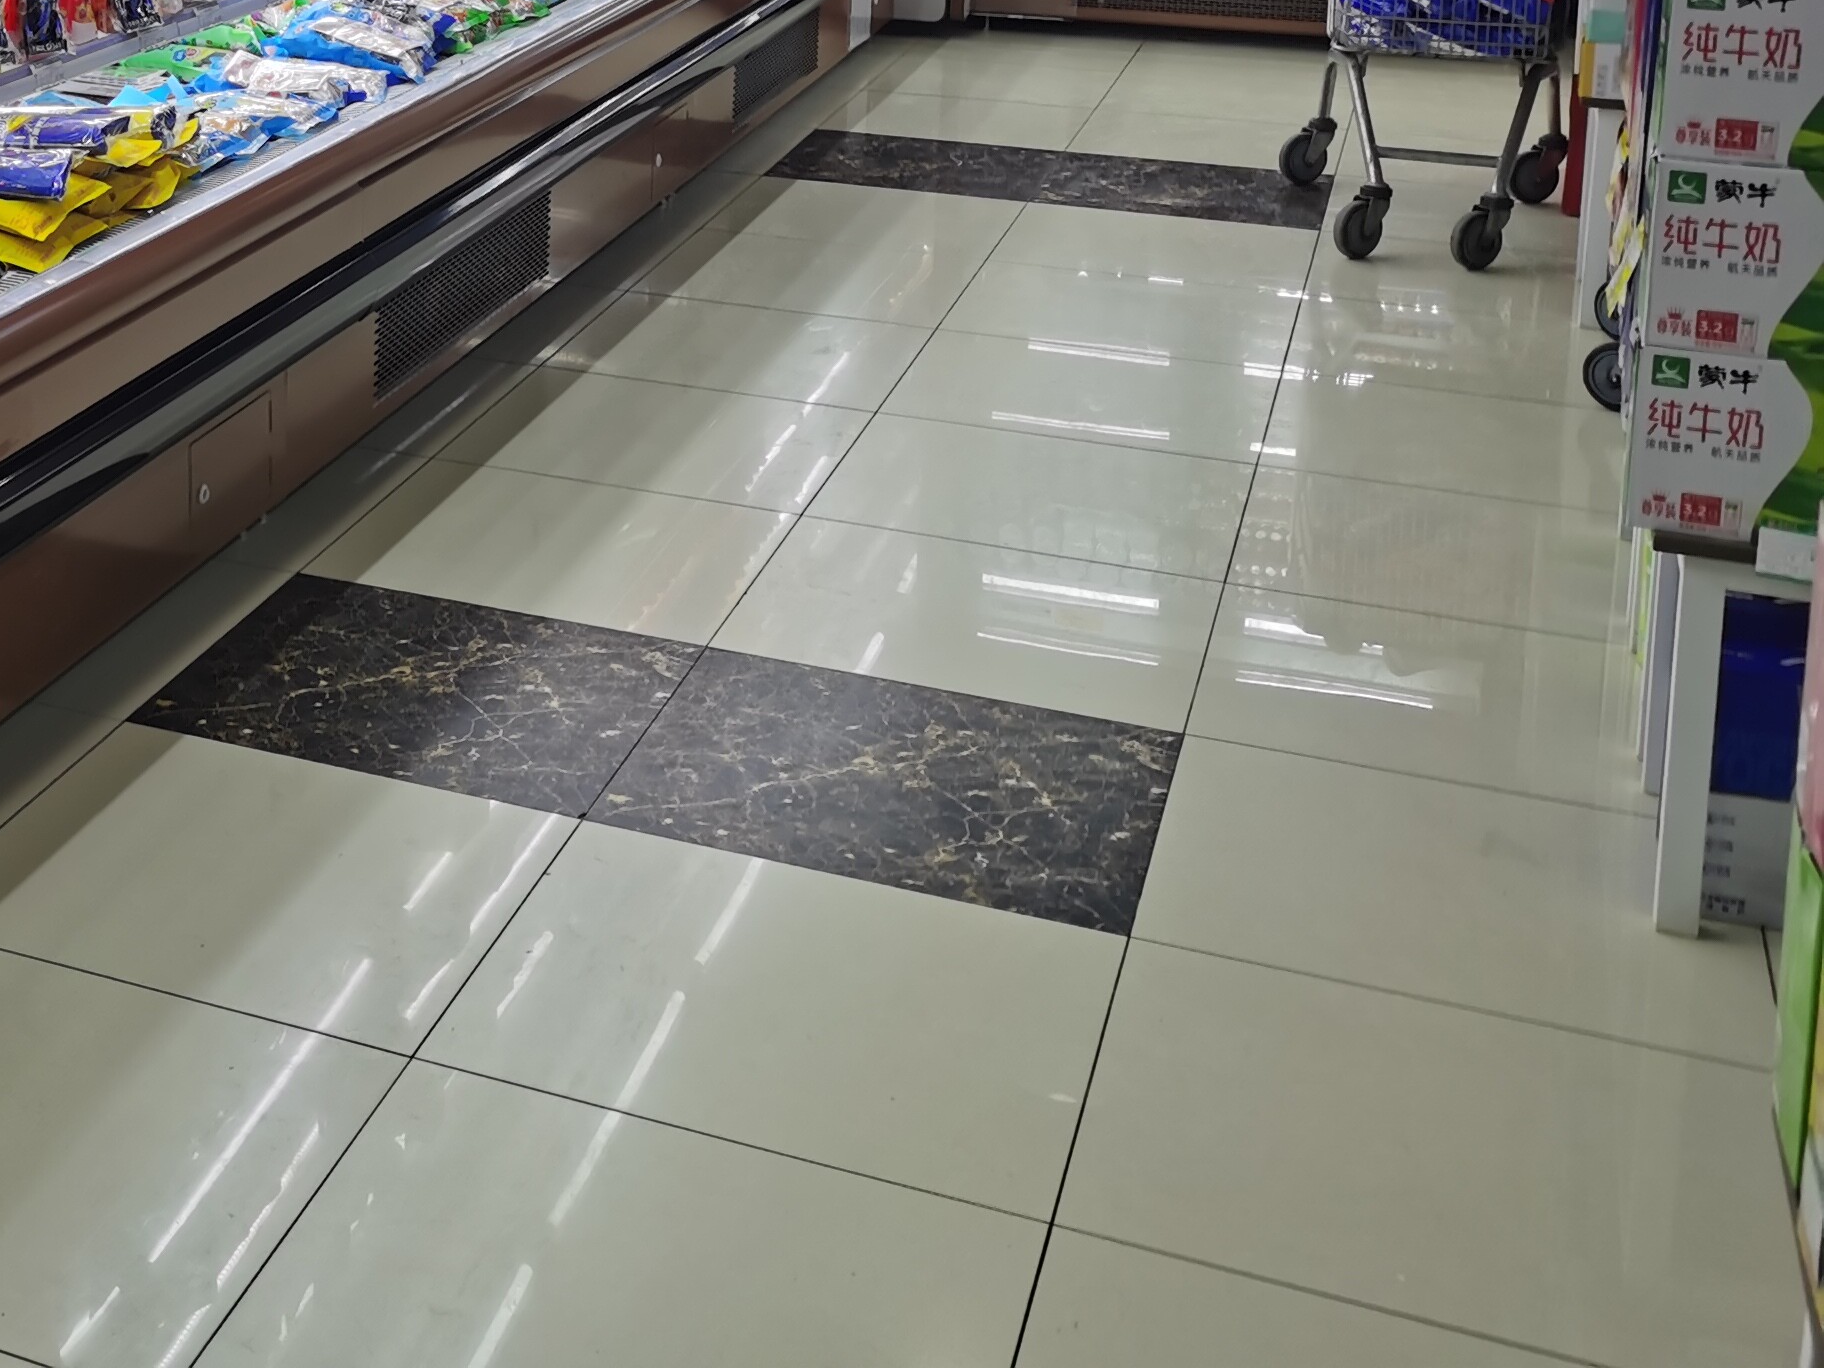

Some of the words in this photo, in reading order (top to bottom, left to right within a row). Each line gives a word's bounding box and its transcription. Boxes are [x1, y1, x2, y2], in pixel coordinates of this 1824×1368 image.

[1681, 21, 1802, 70] 纯牛奶
[1715, 178, 1776, 208] 蒙牛
[1663, 214, 1781, 265] 纯牛奶
[1698, 363, 1759, 395] 蒙牛
[1648, 397, 1764, 450] 纯牛奶
